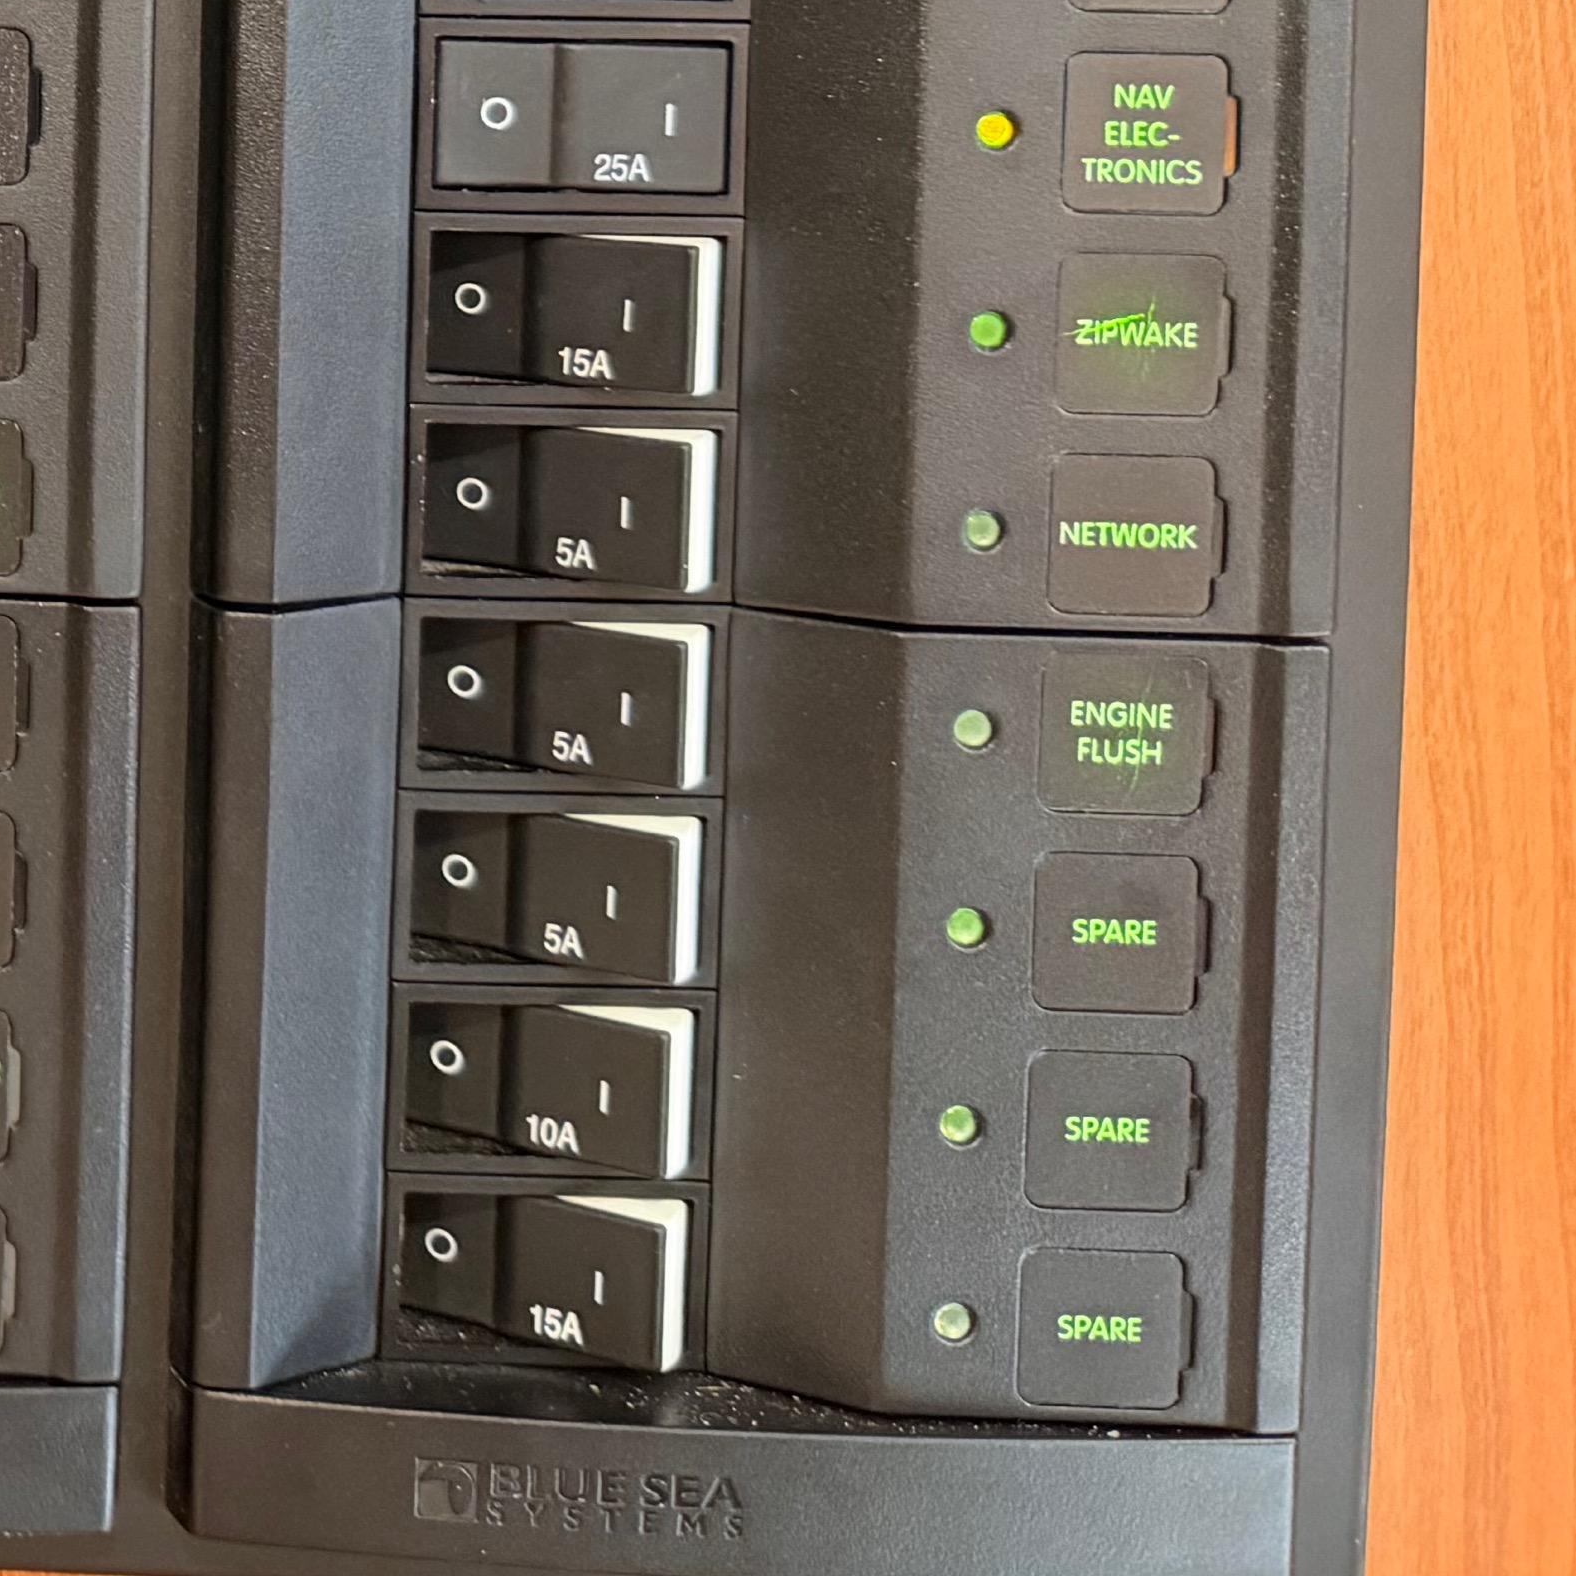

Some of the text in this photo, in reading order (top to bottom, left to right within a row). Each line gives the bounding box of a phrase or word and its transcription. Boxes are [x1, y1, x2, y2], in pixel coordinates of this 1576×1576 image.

[1114, 84, 1174, 109] NAV
[1105, 121, 1180, 146] ELEC-
[594, 154, 651, 182] 25A
[1082, 158, 1202, 184] TRONICS
[559, 347, 612, 379] 15A
[1060, 522, 1197, 548] NETWORK
[556, 538, 594, 569] 5A
[1071, 701, 1173, 729] ENGINE
[553, 731, 591, 764] 5A
[1078, 737, 1162, 767] FLUSH
[544, 923, 583, 958] 5A
[1072, 919, 1157, 945] SPARE
[526, 1115, 579, 1154] 10A
[1065, 1117, 1149, 1143] SPARE
[530, 1305, 583, 1345] 15A
[1058, 1315, 1142, 1342] SPARE
[488, 1463, 743, 1510] BLUE SEA
